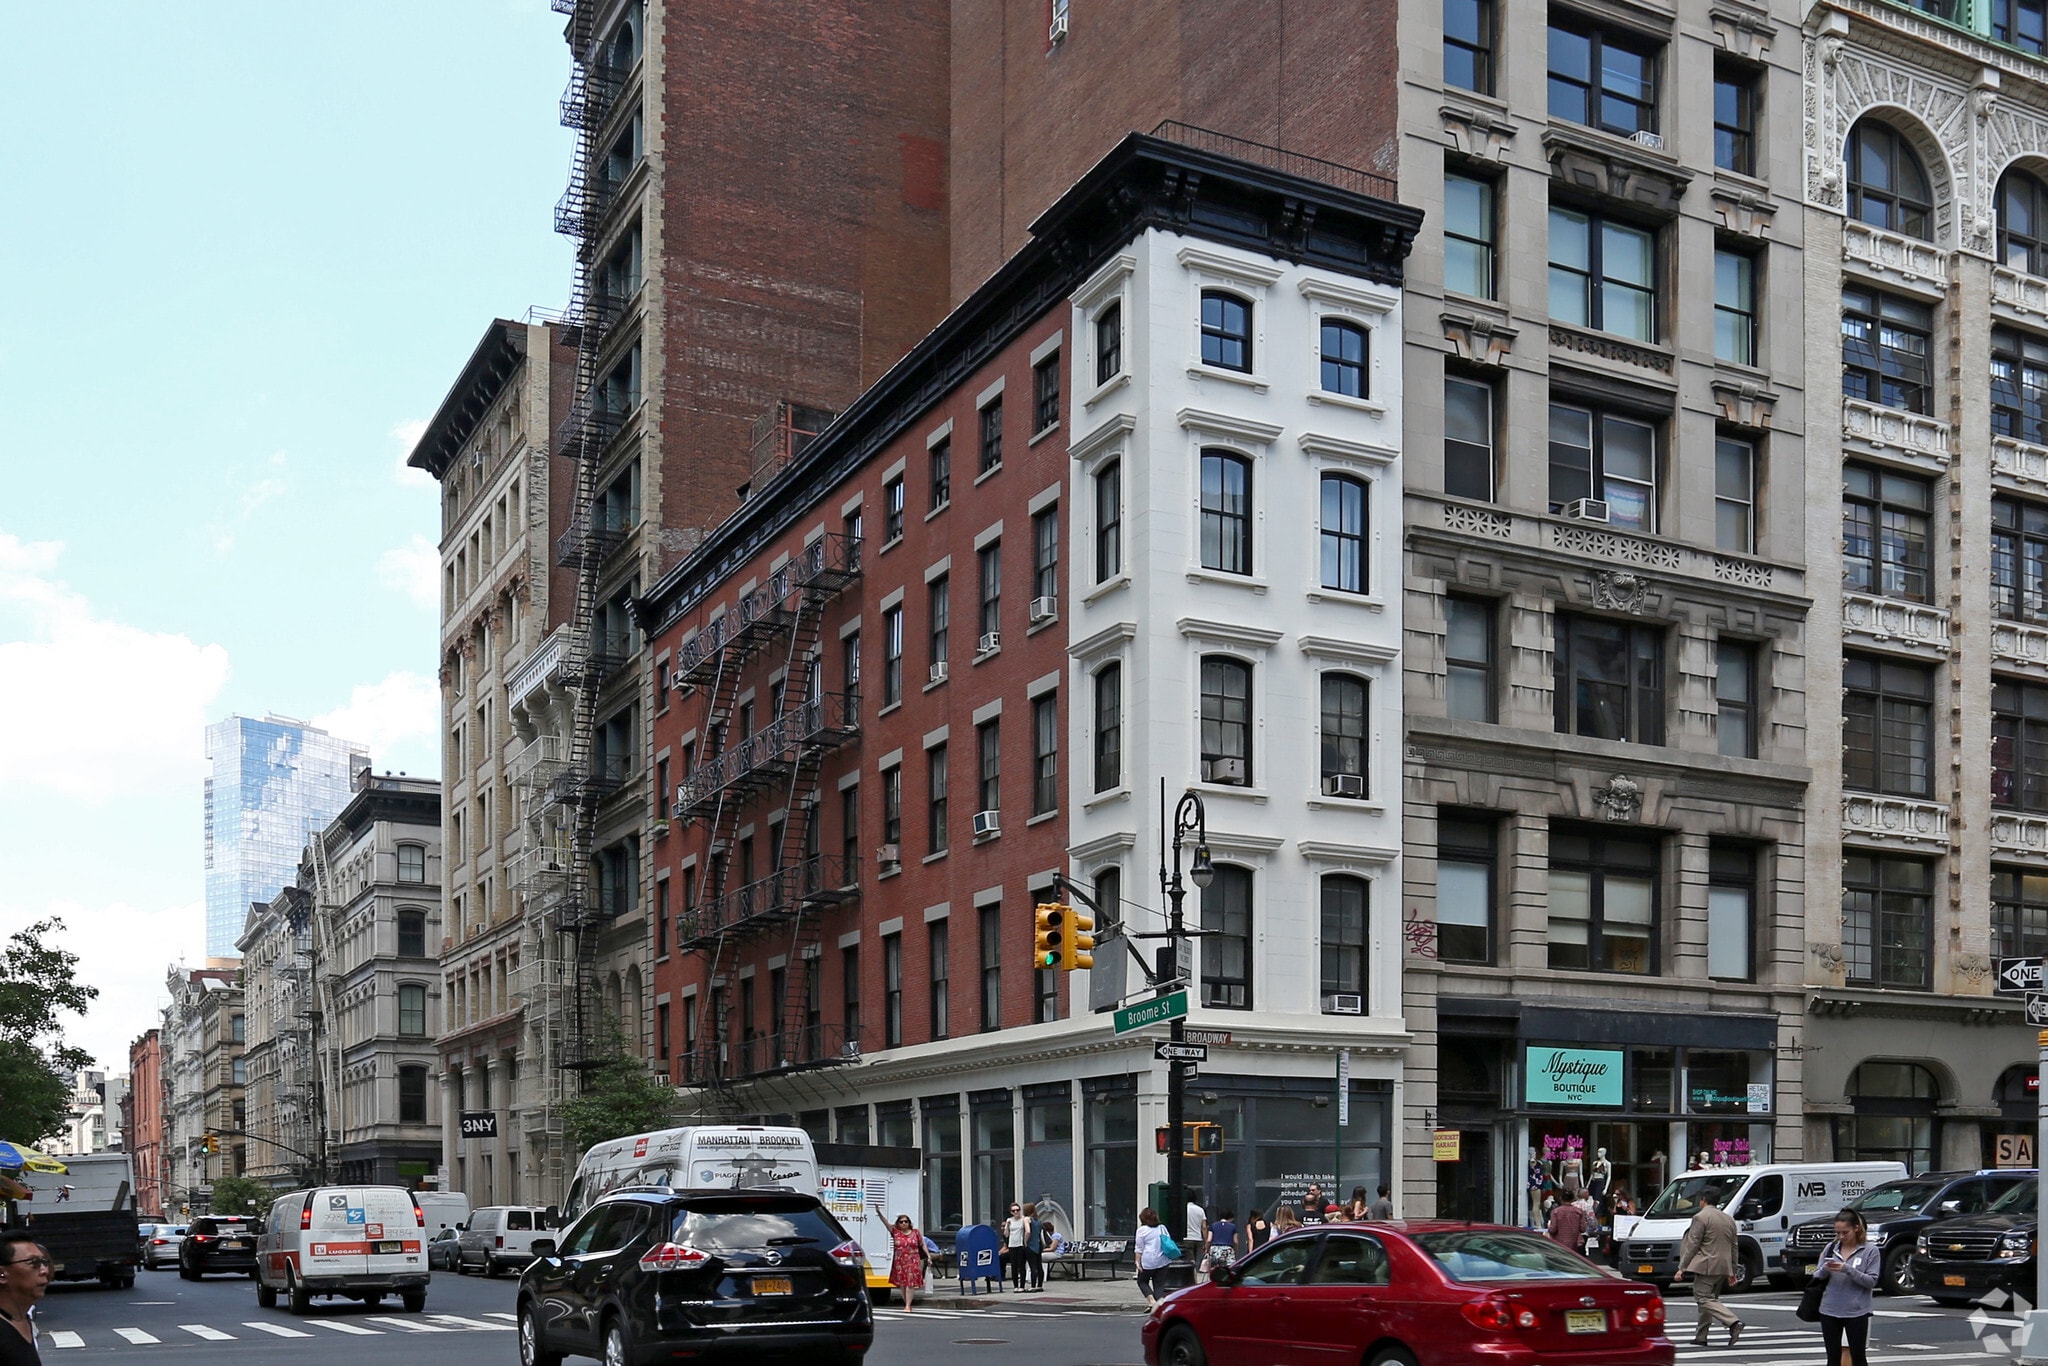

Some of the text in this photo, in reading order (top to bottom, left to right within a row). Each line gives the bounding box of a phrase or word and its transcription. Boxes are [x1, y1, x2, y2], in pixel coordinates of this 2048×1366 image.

[2010, 968, 2040, 981] ONE
[1128, 1001, 1171, 1025] Broome St
[2031, 1002, 2047, 1016] ONE
[1186, 1031, 1228, 1045] BROADWAY
[1162, 1047, 1201, 1057] ONE WAY
[1541, 1051, 1609, 1084] Mystique
[1553, 1083, 1597, 1093] BOUTIQUE
[463, 1119, 495, 1133] 3NY
[698, 1136, 750, 1145] MANHATTAN
[759, 1136, 801, 1145] BROOKLYN
[1543, 1134, 1584, 1150] Super Sale
[1713, 1138, 1750, 1152] Super Sale
[2000, 1138, 2031, 1161] SA
[1841, 1180, 1865, 1188] STONE
[1852, 1257, 1862, 1269] P
